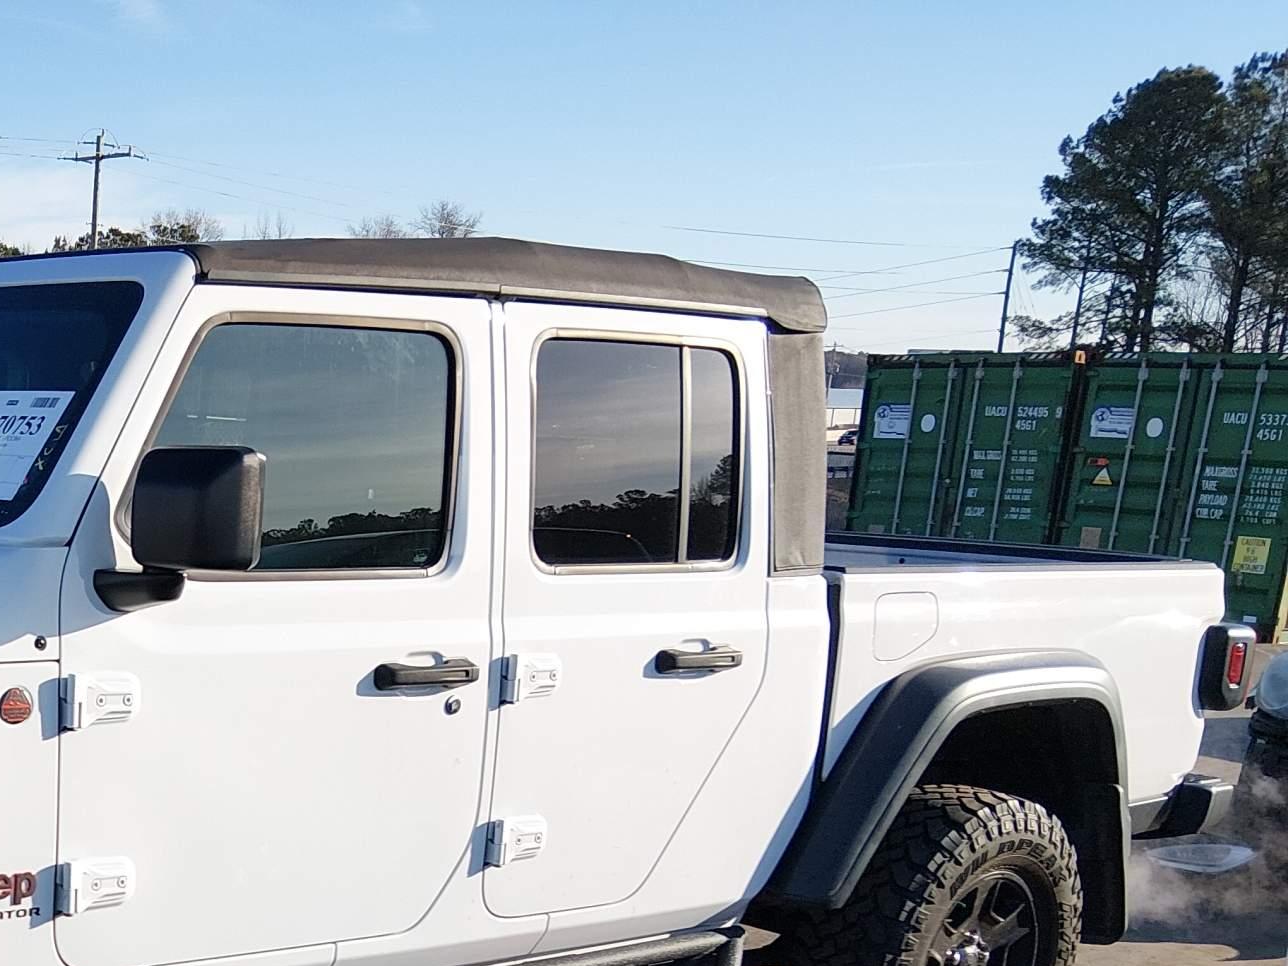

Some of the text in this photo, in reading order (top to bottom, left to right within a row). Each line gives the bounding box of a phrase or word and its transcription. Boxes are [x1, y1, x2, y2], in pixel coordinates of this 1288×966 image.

[984, 405, 1008, 417] UACU
[1017, 406, 1049, 418] 524495
[1015, 420, 1037, 431] 45G1
[1223, 412, 1288, 426] UACU 5337
[1256, 428, 1283, 441] 45G1
[1201, 479, 1219, 491] TARE
[1198, 493, 1228, 506] PAYLOAD
[1240, 537, 1266, 546] CAUTION
